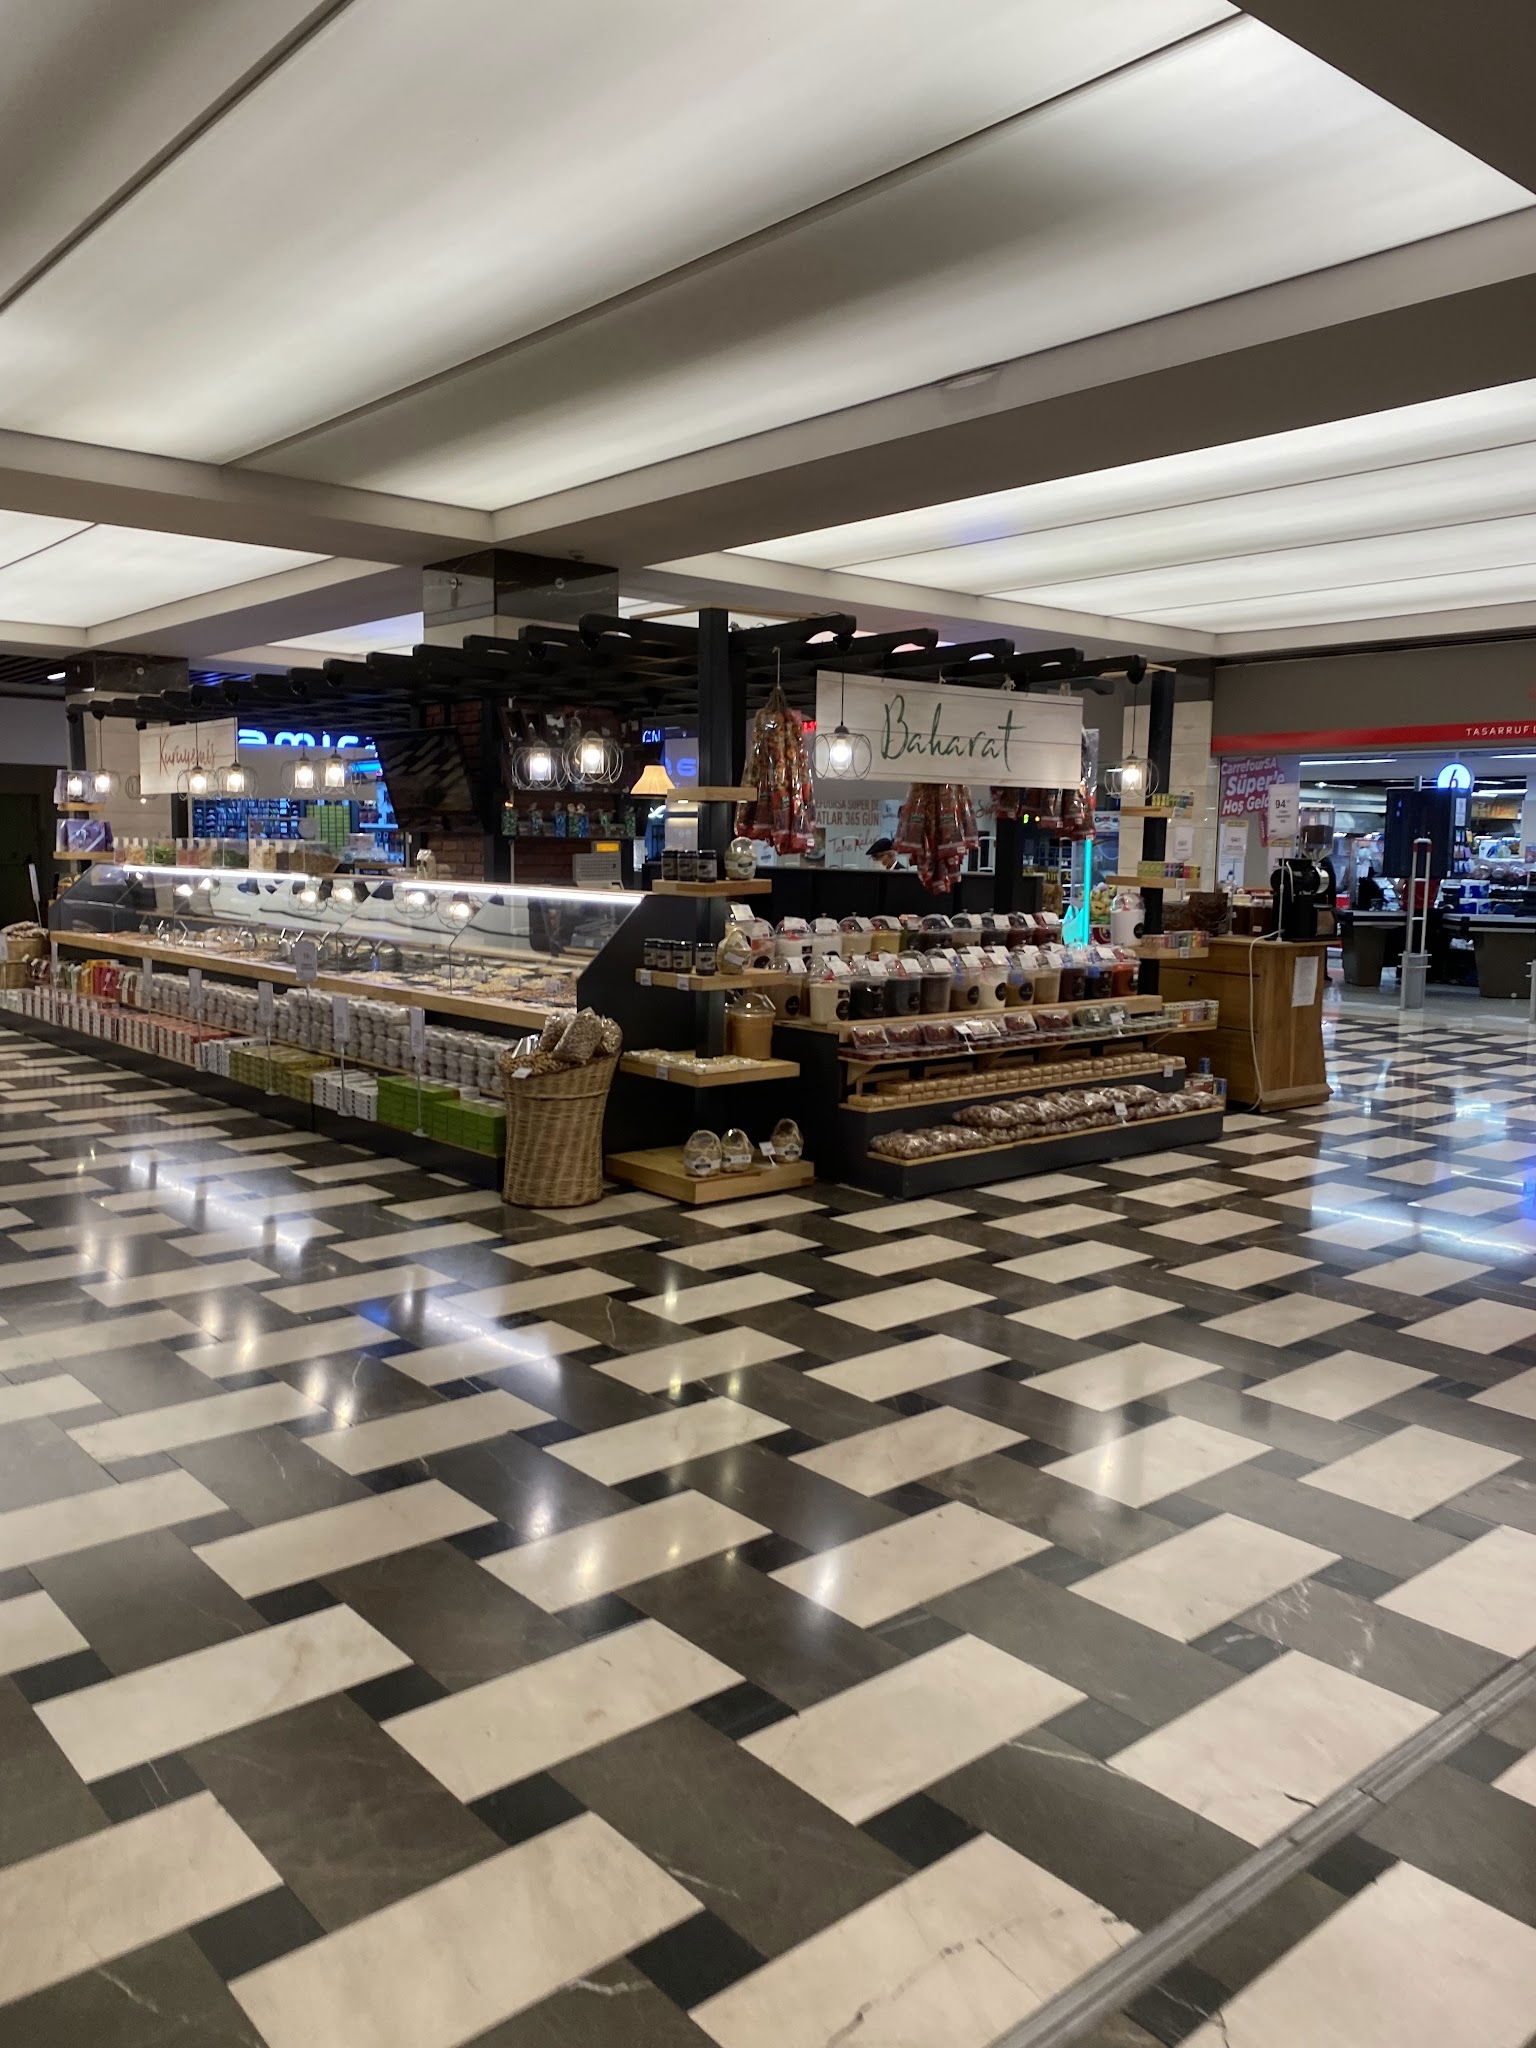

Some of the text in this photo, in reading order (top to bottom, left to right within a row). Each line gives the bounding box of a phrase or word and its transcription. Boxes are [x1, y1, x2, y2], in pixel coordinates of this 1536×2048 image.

[881, 694, 1027, 773] Baharat
[1221, 757, 1278, 775] CarrefourSA
[1222, 799, 1245, 816] Hoş
